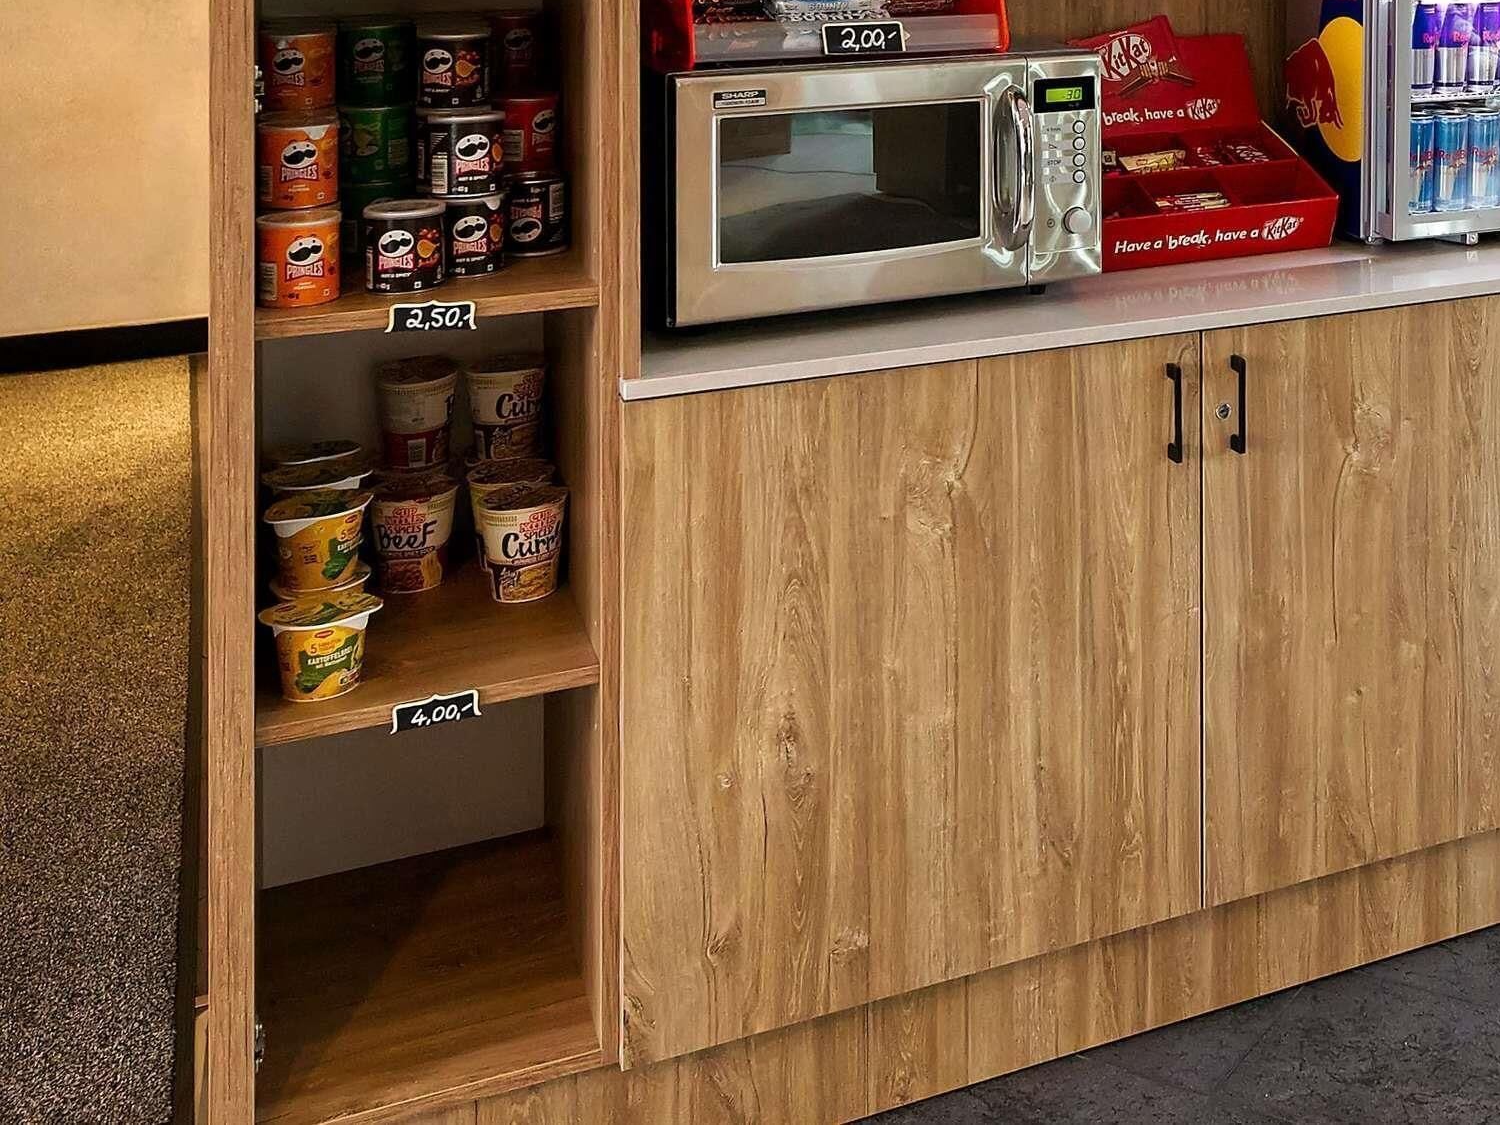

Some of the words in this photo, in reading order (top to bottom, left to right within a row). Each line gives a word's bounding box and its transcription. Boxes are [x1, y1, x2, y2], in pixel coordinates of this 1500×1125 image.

[721, 90, 759, 100] SHARP
[1144, 107, 1174, 121] have
[1176, 108, 1185, 118] a
[281, 165, 319, 182] PRINGLES
[455, 156, 490, 174] PRINGLES
[453, 237, 488, 255] PRINGLES
[1113, 236, 1151, 254] Have
[1153, 239, 1163, 250] a
[1215, 226, 1247, 242] have
[1250, 228, 1259, 238] a
[286, 260, 324, 280] PRINGLES
[378, 253, 415, 271] PRINGLES
[309, 642, 318, 654] 5
